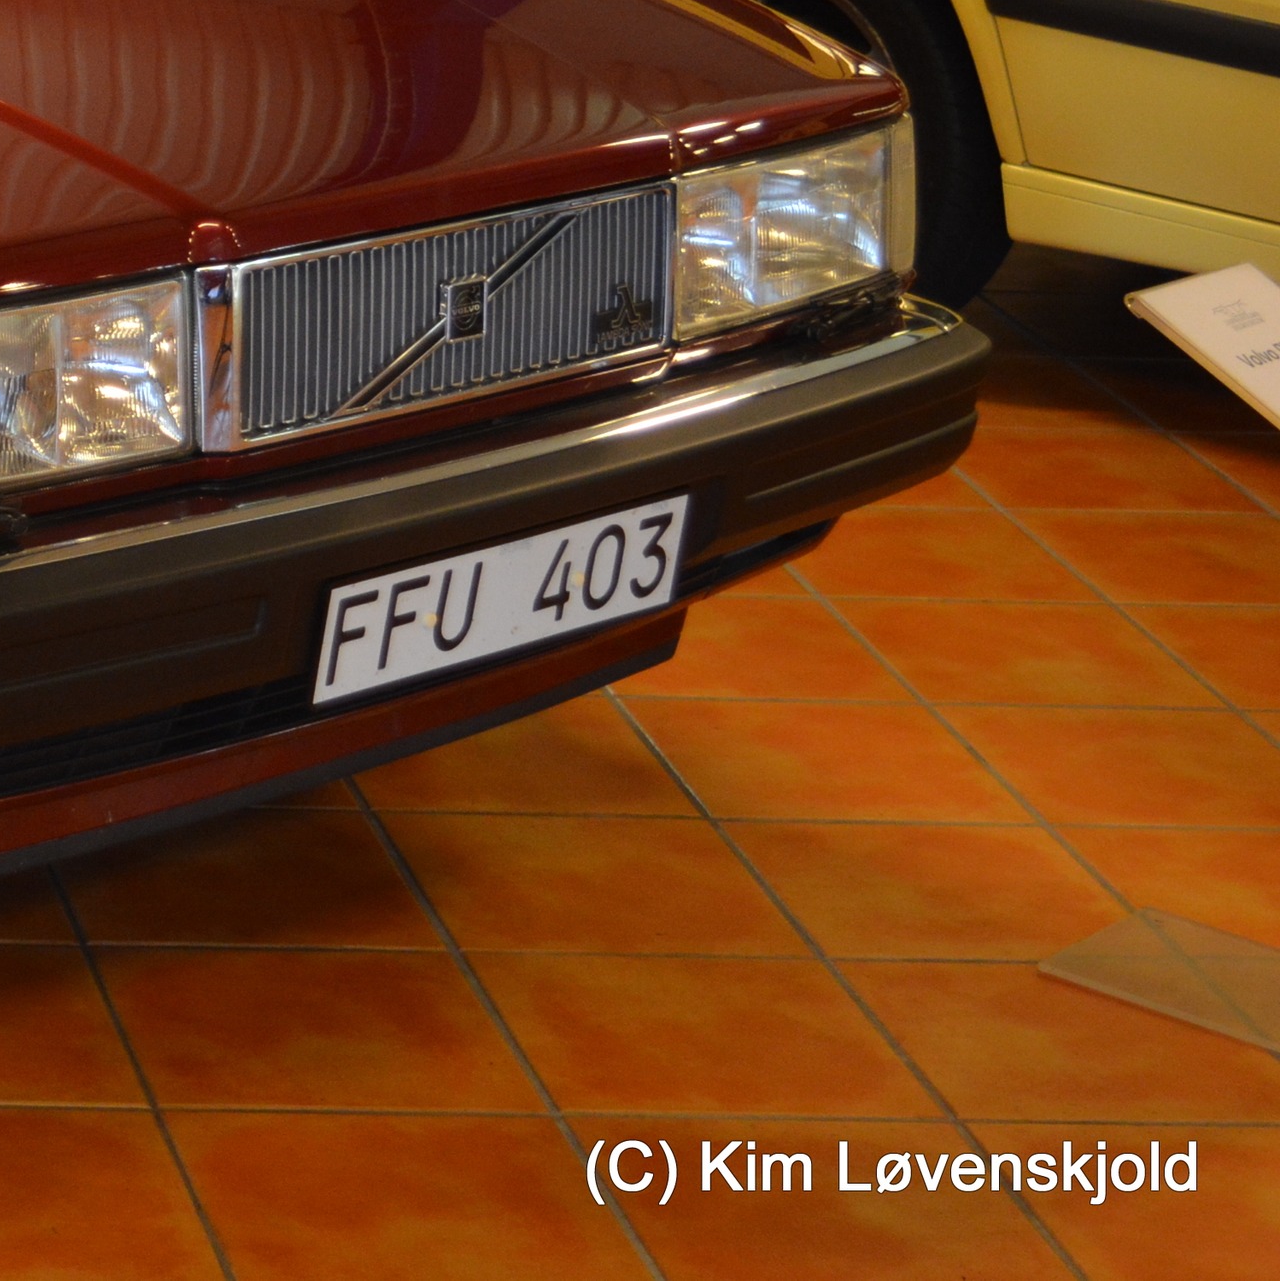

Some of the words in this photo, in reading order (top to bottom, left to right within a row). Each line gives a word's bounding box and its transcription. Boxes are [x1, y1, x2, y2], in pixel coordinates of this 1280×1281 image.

[451, 304, 480, 316] VOLVO
[1236, 349, 1279, 368] Volvo
[325, 561, 483, 687] FFU
[533, 512, 673, 621] 403
